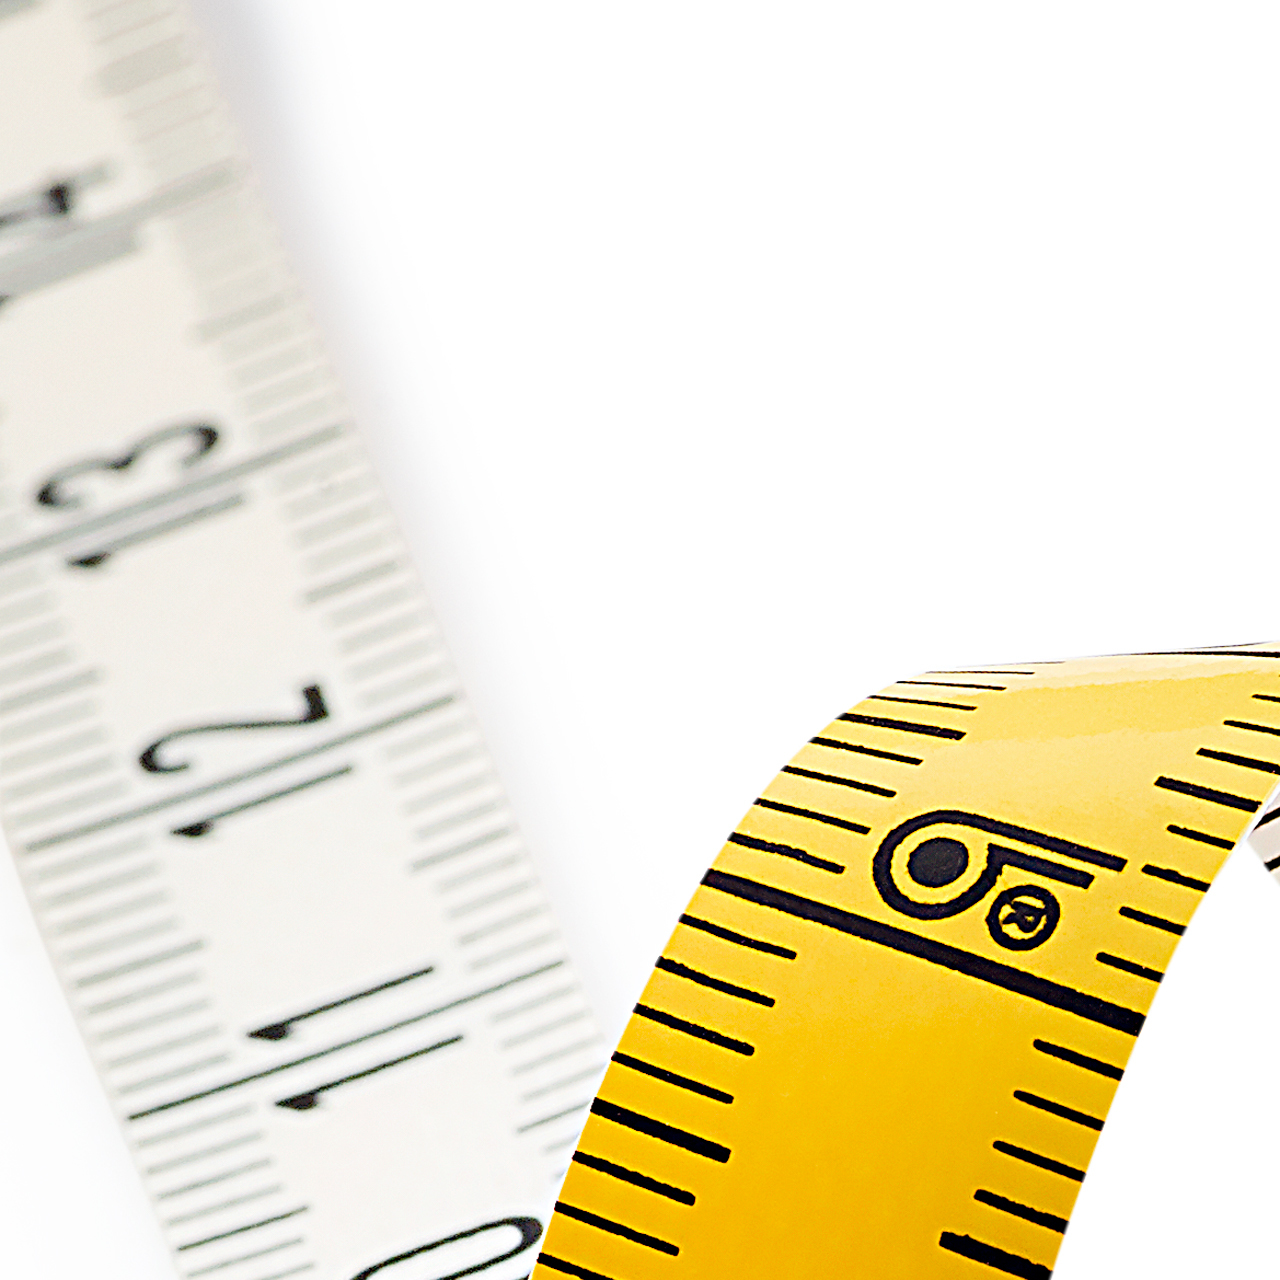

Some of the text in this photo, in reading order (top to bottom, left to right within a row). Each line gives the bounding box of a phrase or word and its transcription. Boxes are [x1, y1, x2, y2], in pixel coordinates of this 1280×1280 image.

[36, 421, 246, 570] 13
[138, 683, 354, 838] 12
[246, 966, 464, 1111] 11
